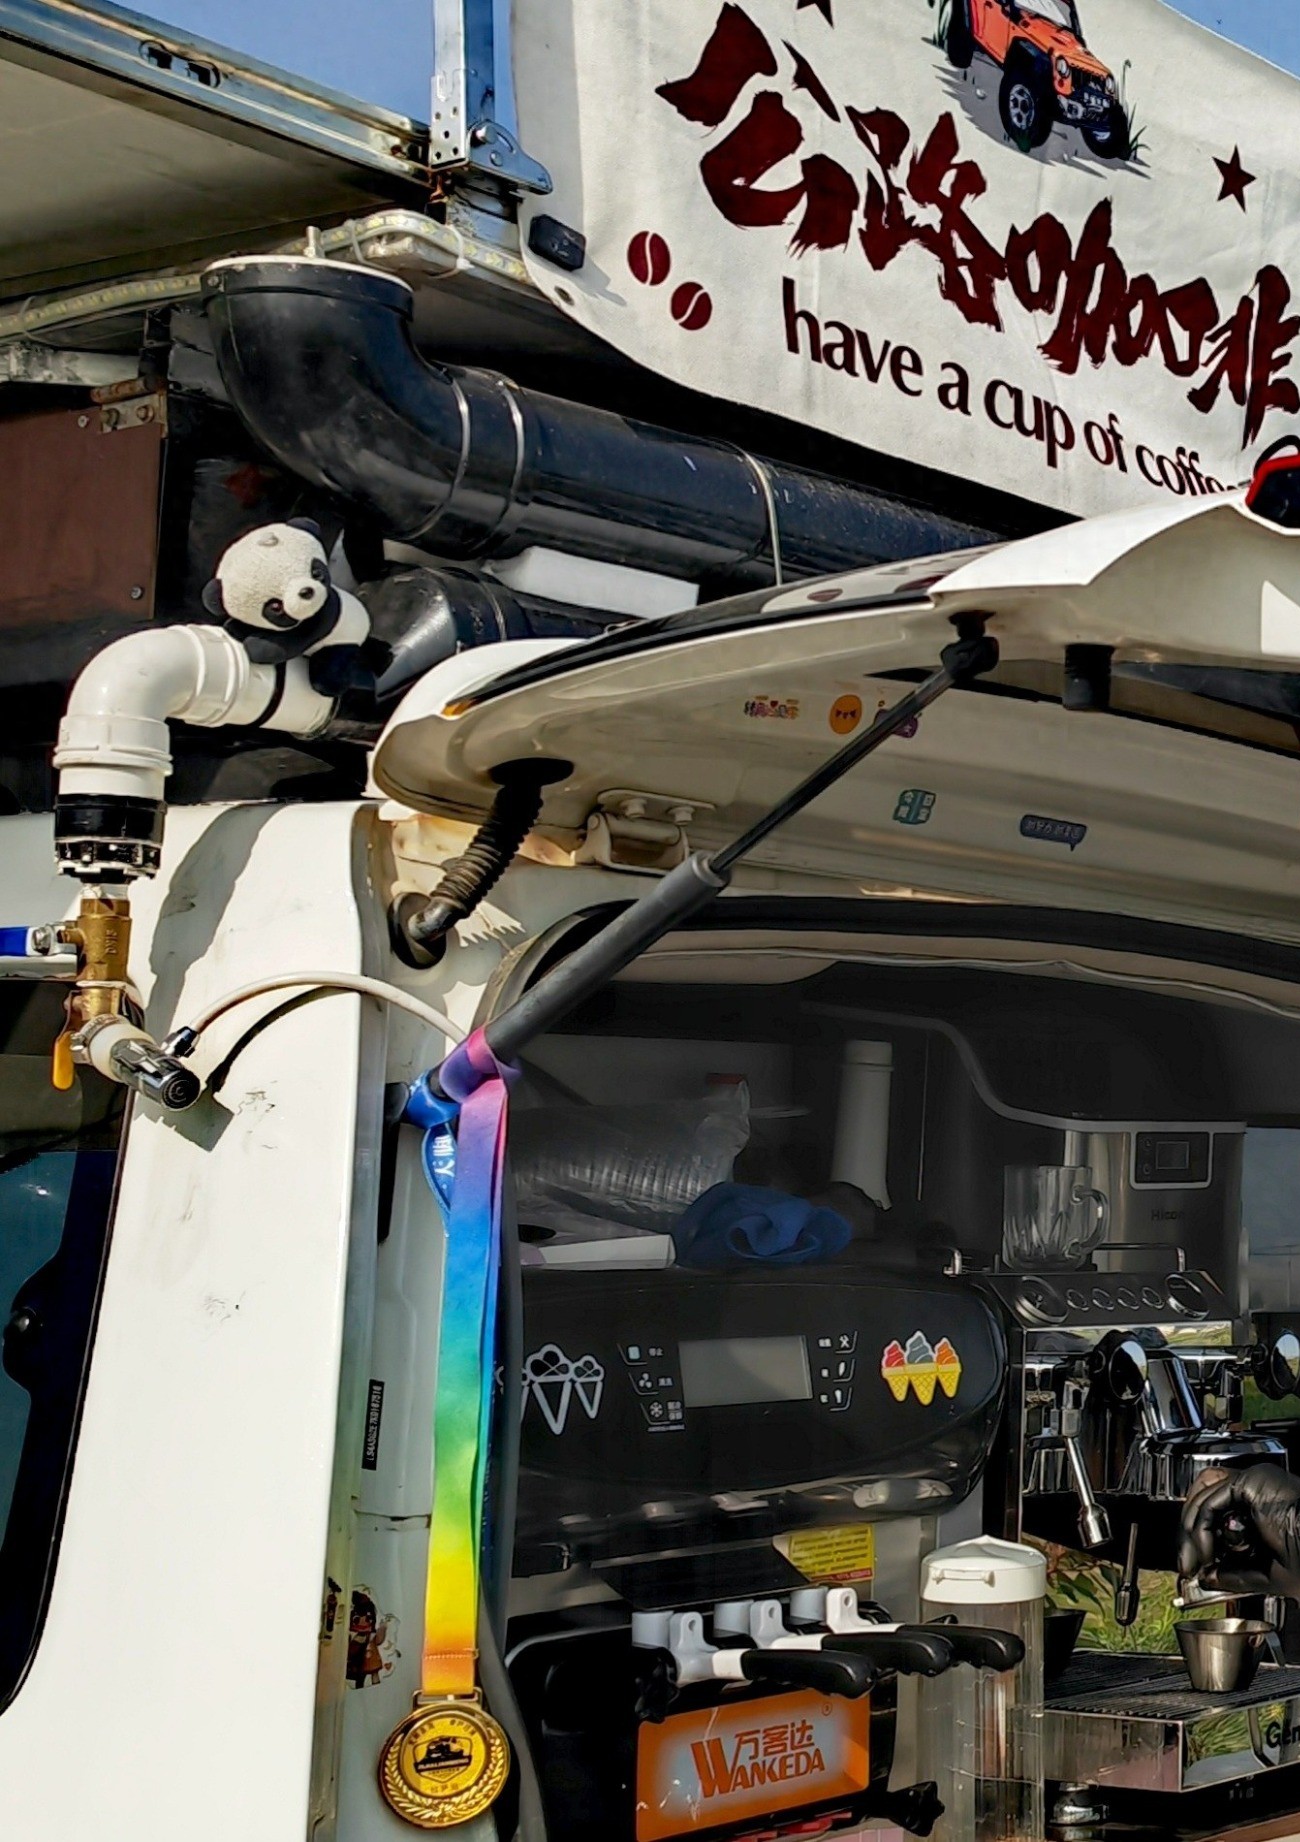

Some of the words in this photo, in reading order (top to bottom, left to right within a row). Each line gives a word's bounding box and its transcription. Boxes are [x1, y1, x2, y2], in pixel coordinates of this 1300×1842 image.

[782, 276, 923, 397] have
[937, 362, 972, 417] a
[984, 379, 1075, 469] cup
[1083, 412, 1128, 474] of
[734, 1719, 815, 1761] 万客达
